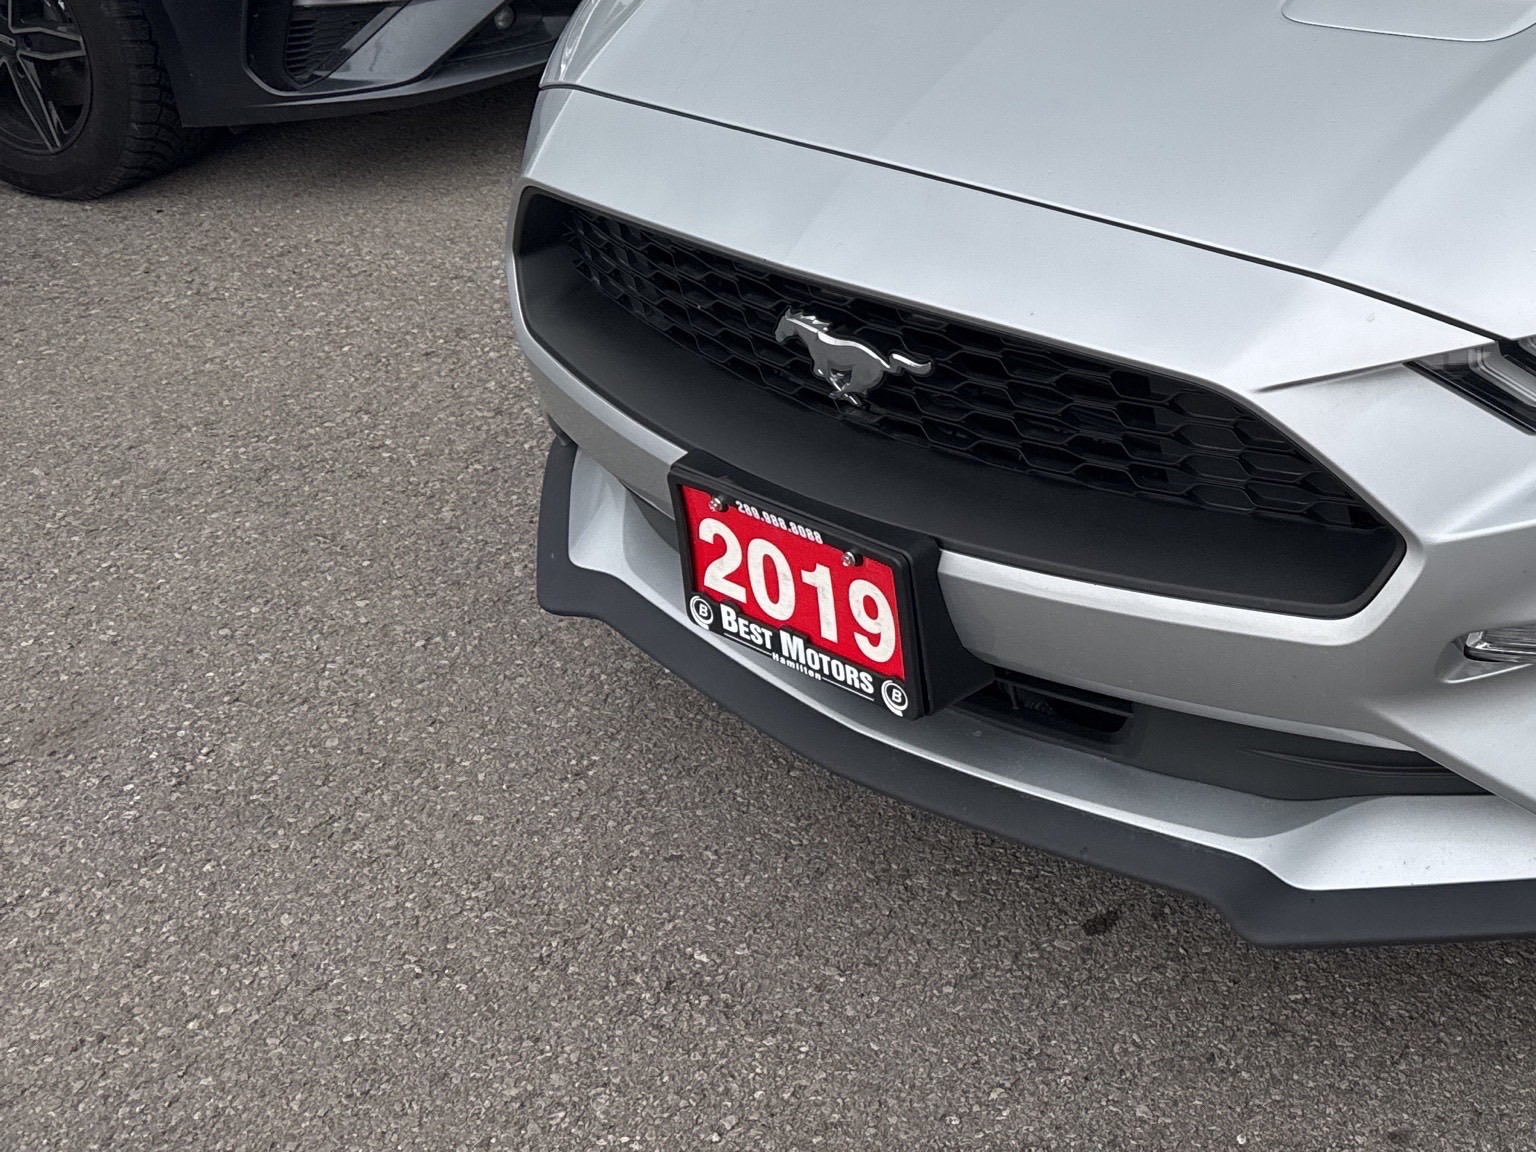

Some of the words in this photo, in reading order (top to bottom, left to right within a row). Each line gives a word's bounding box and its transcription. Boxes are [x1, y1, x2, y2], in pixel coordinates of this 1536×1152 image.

[735, 500, 823, 545] 289.988.8088
[699, 517, 896, 663] 2019
[720, 603, 773, 649] BEST
[779, 628, 875, 695] MOTORS
[772, 652, 822, 681] Hamilton
